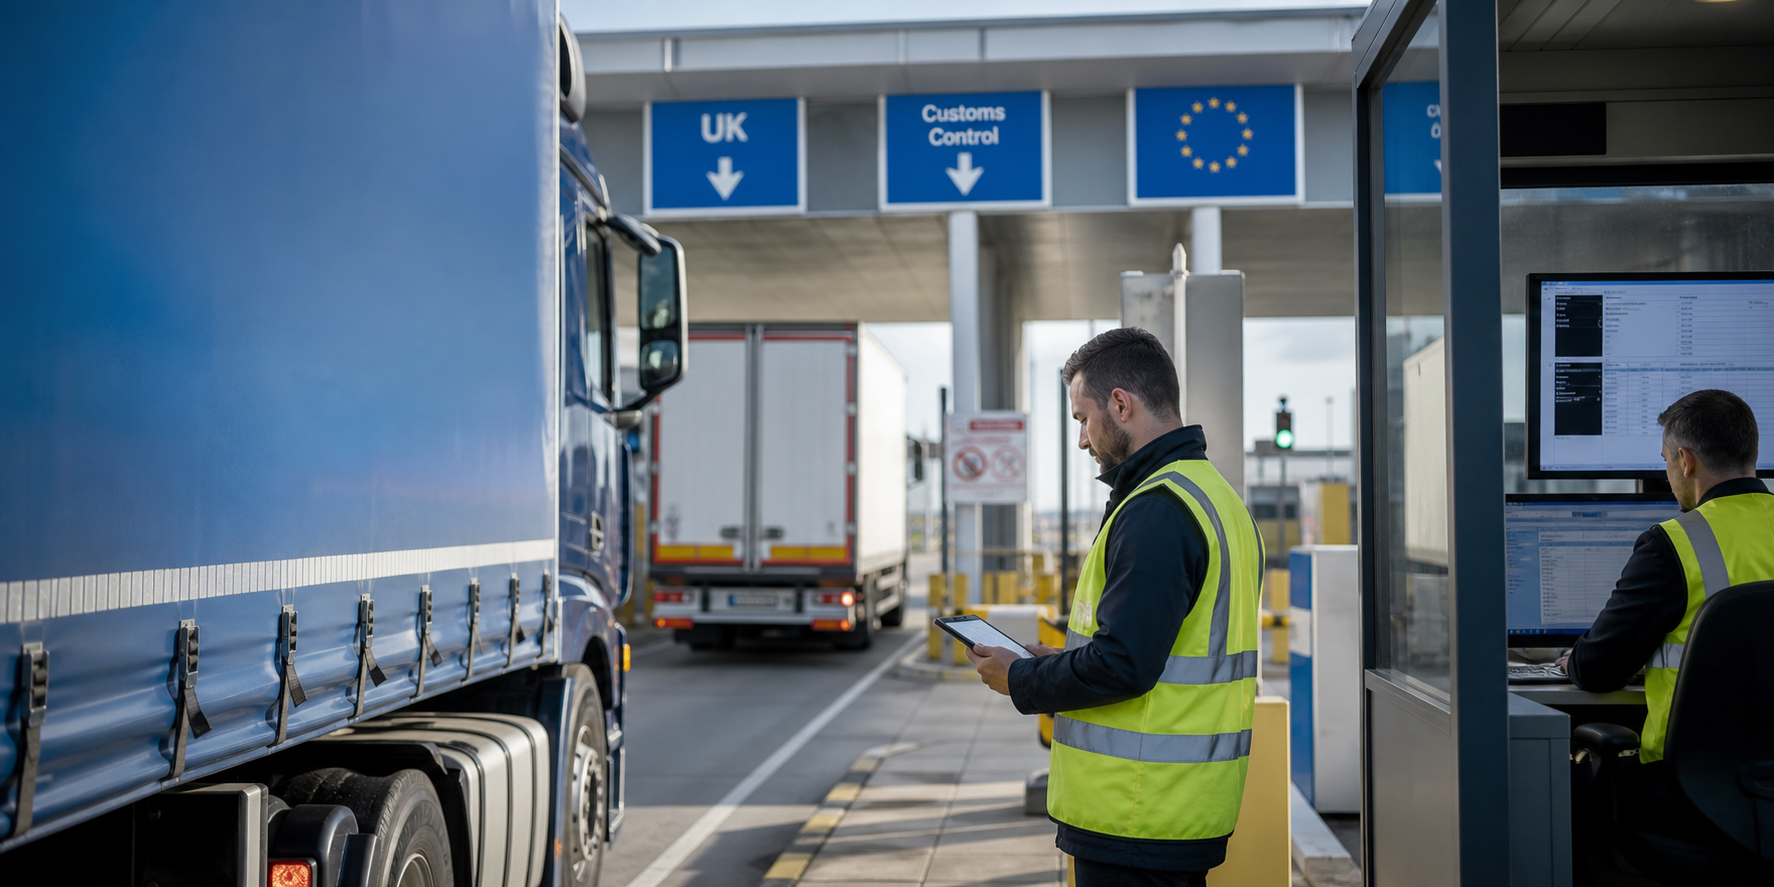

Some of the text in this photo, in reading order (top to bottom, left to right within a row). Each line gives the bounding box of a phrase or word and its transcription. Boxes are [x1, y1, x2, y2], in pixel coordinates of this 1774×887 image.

[921, 103, 1007, 123] Customs
[700, 111, 749, 144] UK
[928, 126, 1000, 147] Control
